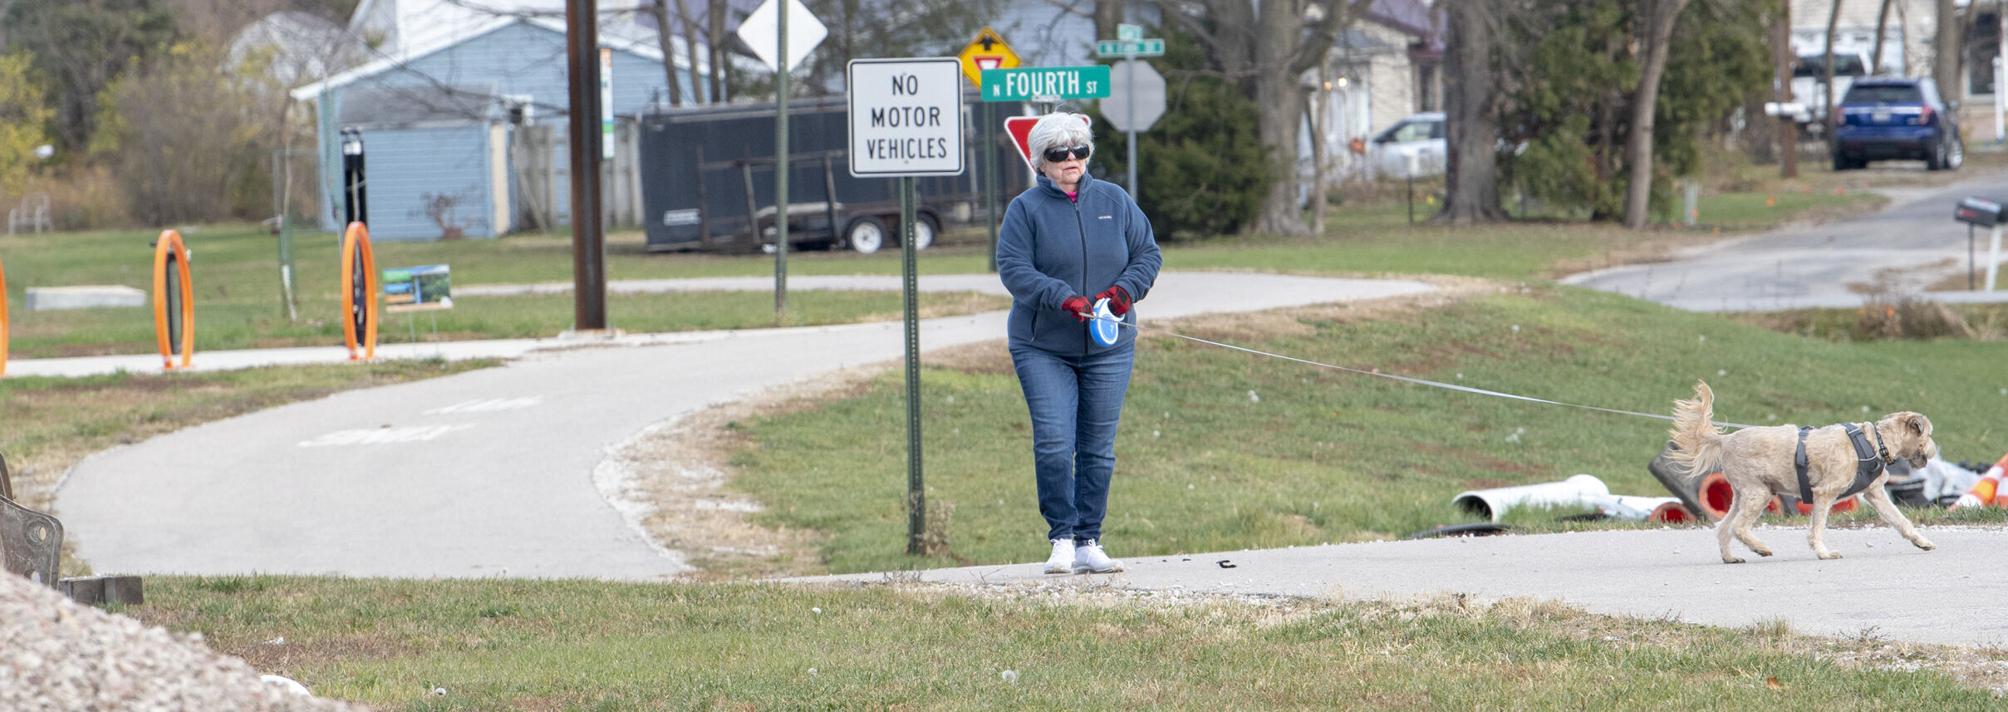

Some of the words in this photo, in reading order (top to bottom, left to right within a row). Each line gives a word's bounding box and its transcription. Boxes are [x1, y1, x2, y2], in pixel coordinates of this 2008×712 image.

[892, 74, 918, 95] NO
[993, 83, 1000, 97] N
[1006, 71, 1080, 97] FOURTH
[1086, 80, 1097, 94] ST
[871, 106, 940, 127] MOTOR
[867, 137, 947, 160] VEHICLES
